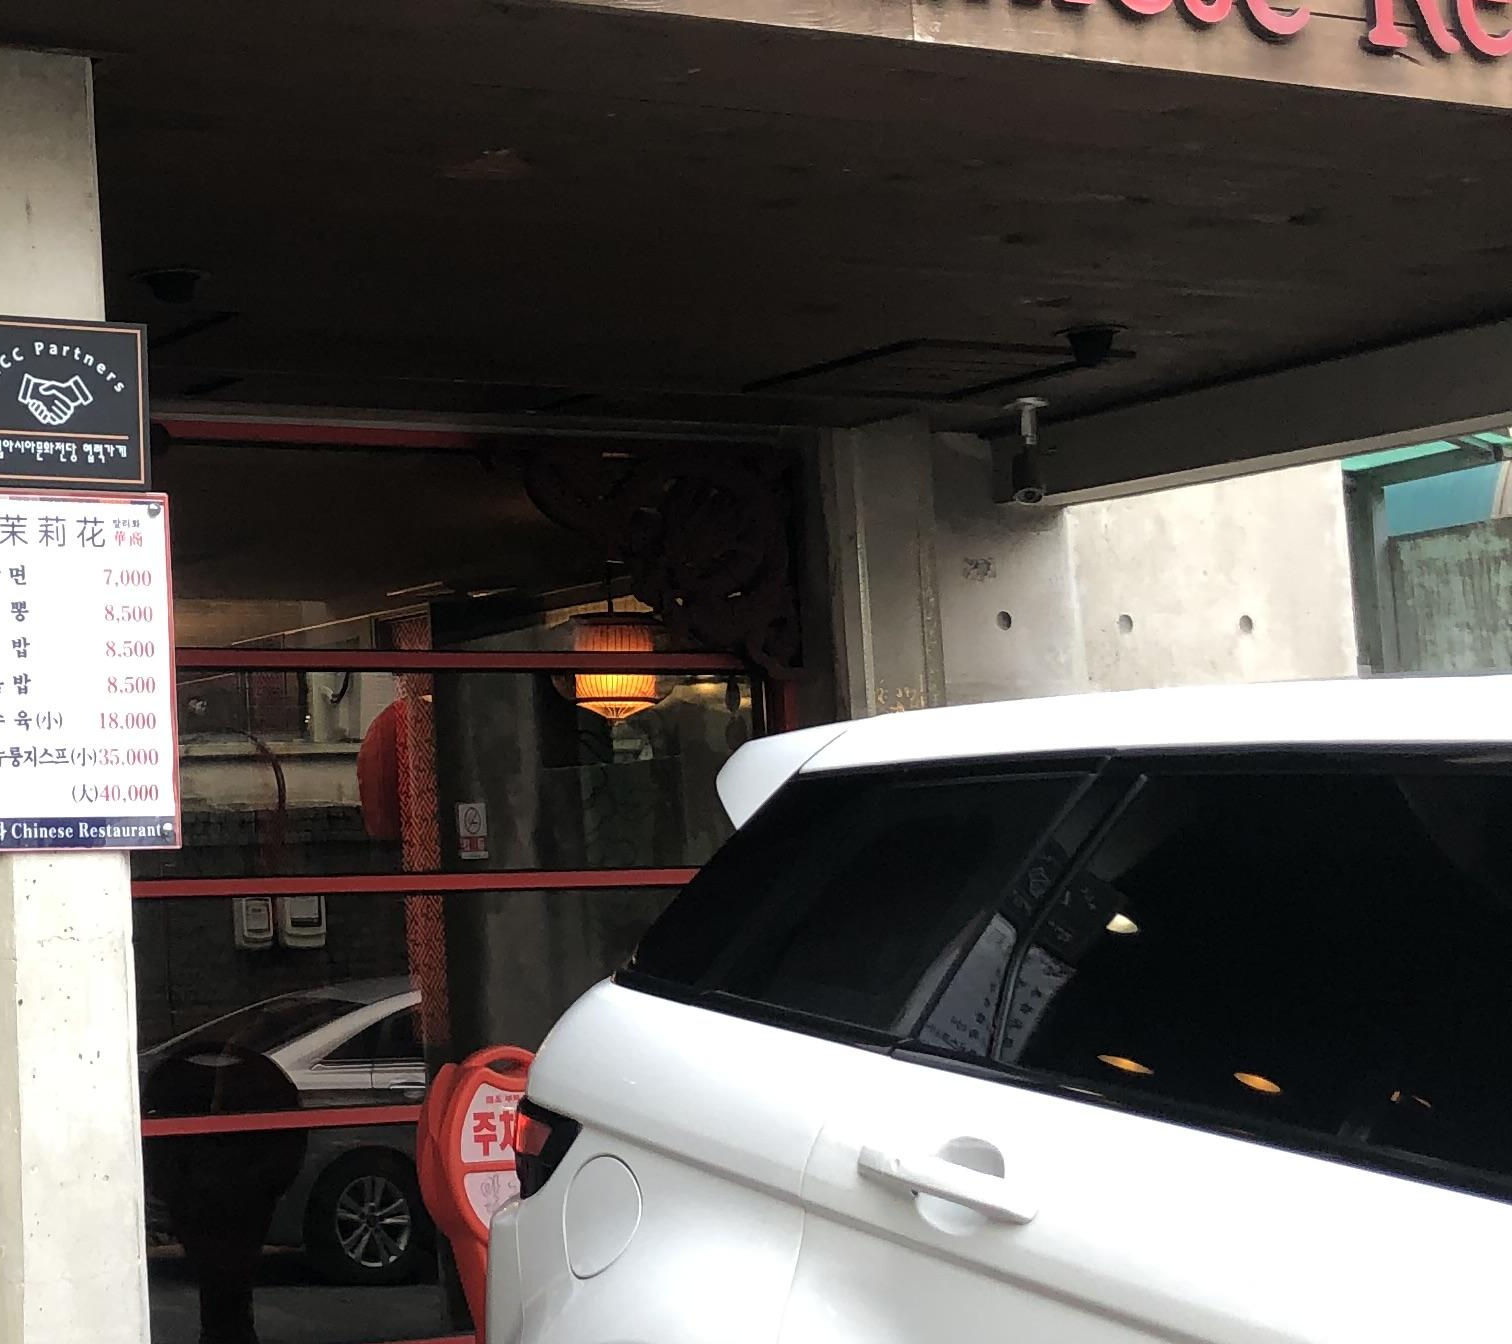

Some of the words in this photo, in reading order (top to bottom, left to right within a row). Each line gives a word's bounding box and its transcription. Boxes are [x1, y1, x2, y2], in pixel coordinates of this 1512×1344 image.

[34, 341, 125, 393] Partners
[82, 442, 128, 464] 협력가게
[11, 822, 74, 839] Chinese
[79, 821, 162, 838] Restaurant
